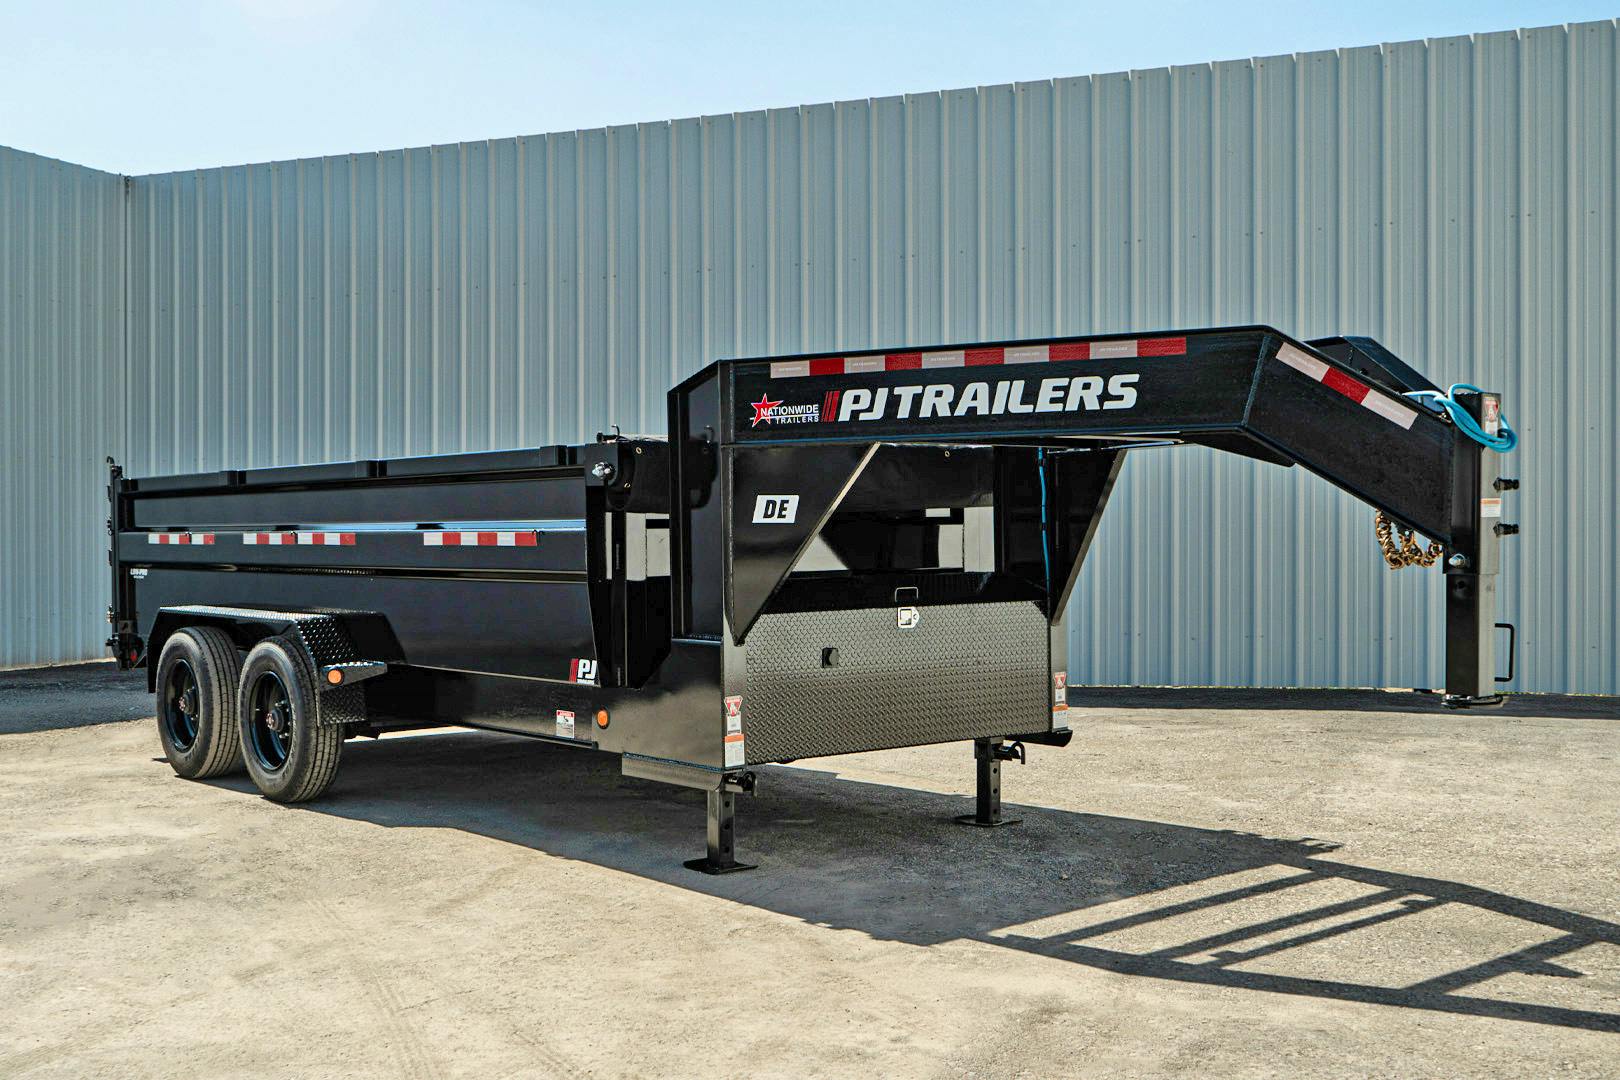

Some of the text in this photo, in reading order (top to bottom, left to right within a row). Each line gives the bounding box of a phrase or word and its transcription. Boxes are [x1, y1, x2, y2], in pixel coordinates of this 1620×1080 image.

[760, 404, 819, 416] NATIONWIDE
[776, 416, 819, 425] TRAILERS
[763, 499, 790, 519] DE
[577, 659, 597, 680] PJ
